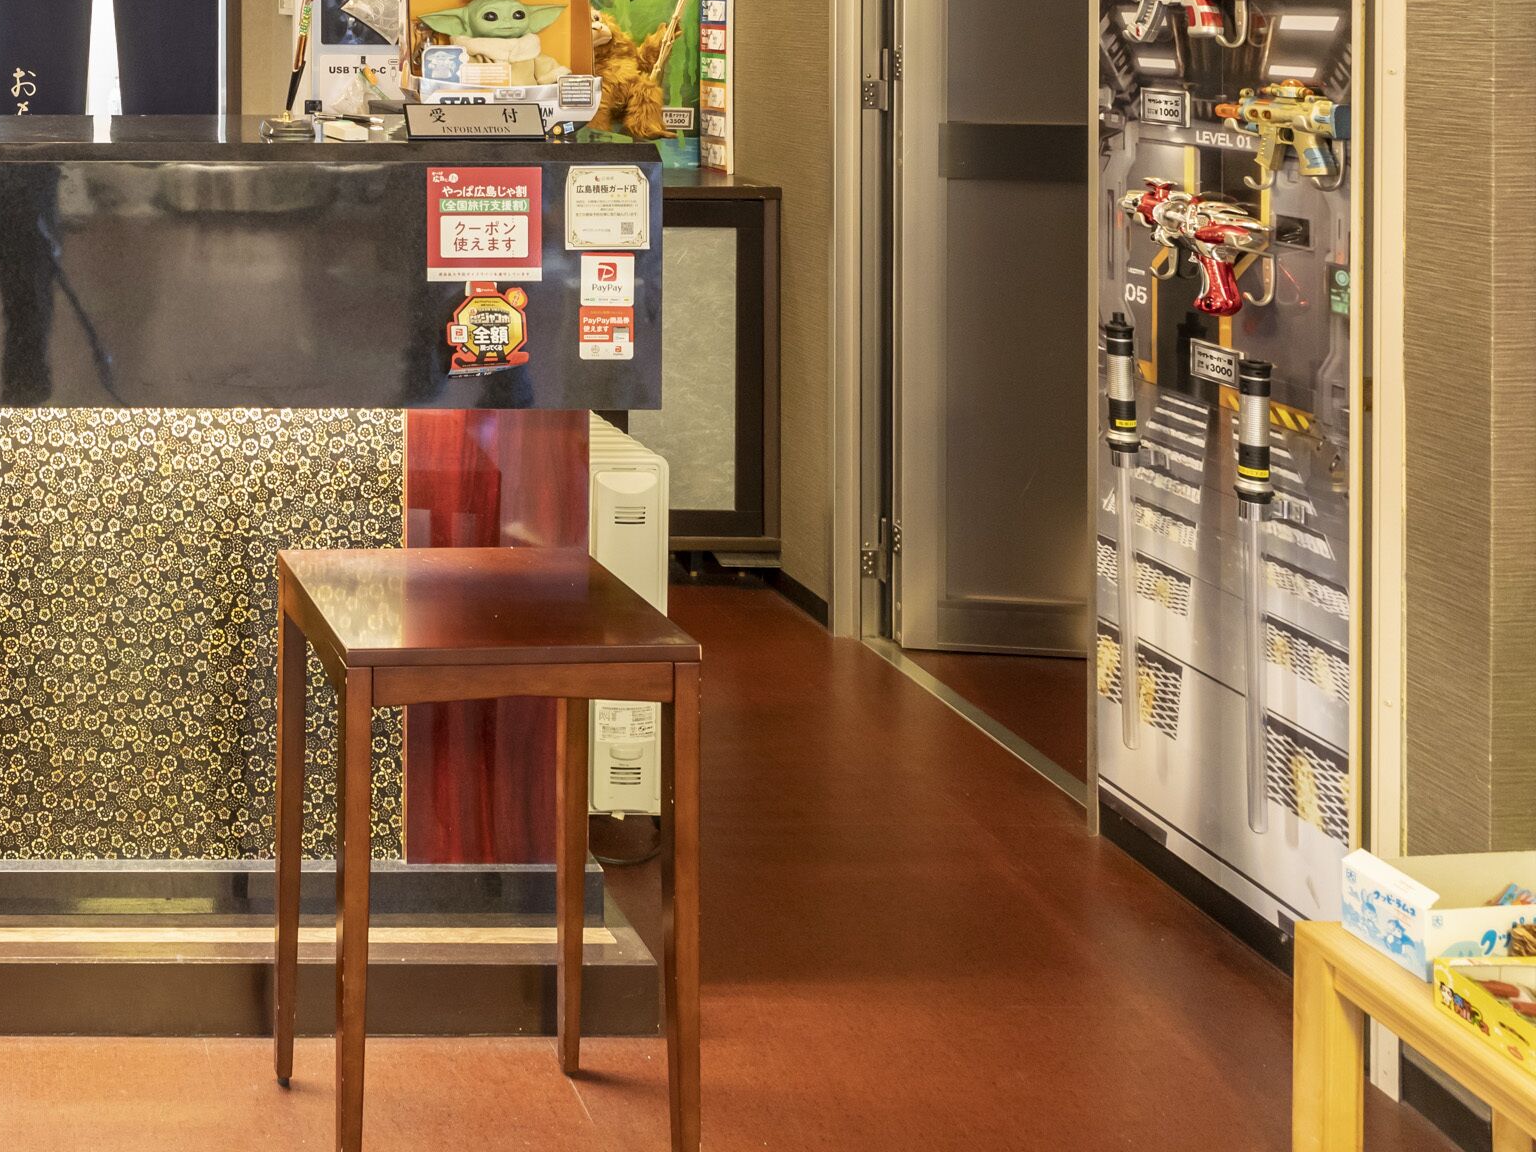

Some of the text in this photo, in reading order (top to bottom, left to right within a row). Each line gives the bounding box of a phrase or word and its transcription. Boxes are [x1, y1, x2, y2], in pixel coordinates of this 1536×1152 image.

[329, 66, 387, 75] USB Tye-C
[429, 107, 518, 123] 受 付
[442, 126, 511, 134] INFORMATION
[1196, 130, 1252, 149] LEVEL 01
[442, 185, 528, 198] やっぱ広島じゃ割
[576, 184, 638, 193] 広島積極ガード店
[441, 200, 528, 212] (全国旅行支援割)
[454, 221, 516, 236] クーポン
[454, 237, 516, 252] 使えます
[592, 283, 623, 294] PayPay
[1124, 283, 1148, 305] 05
[473, 326, 509, 344] 全額
